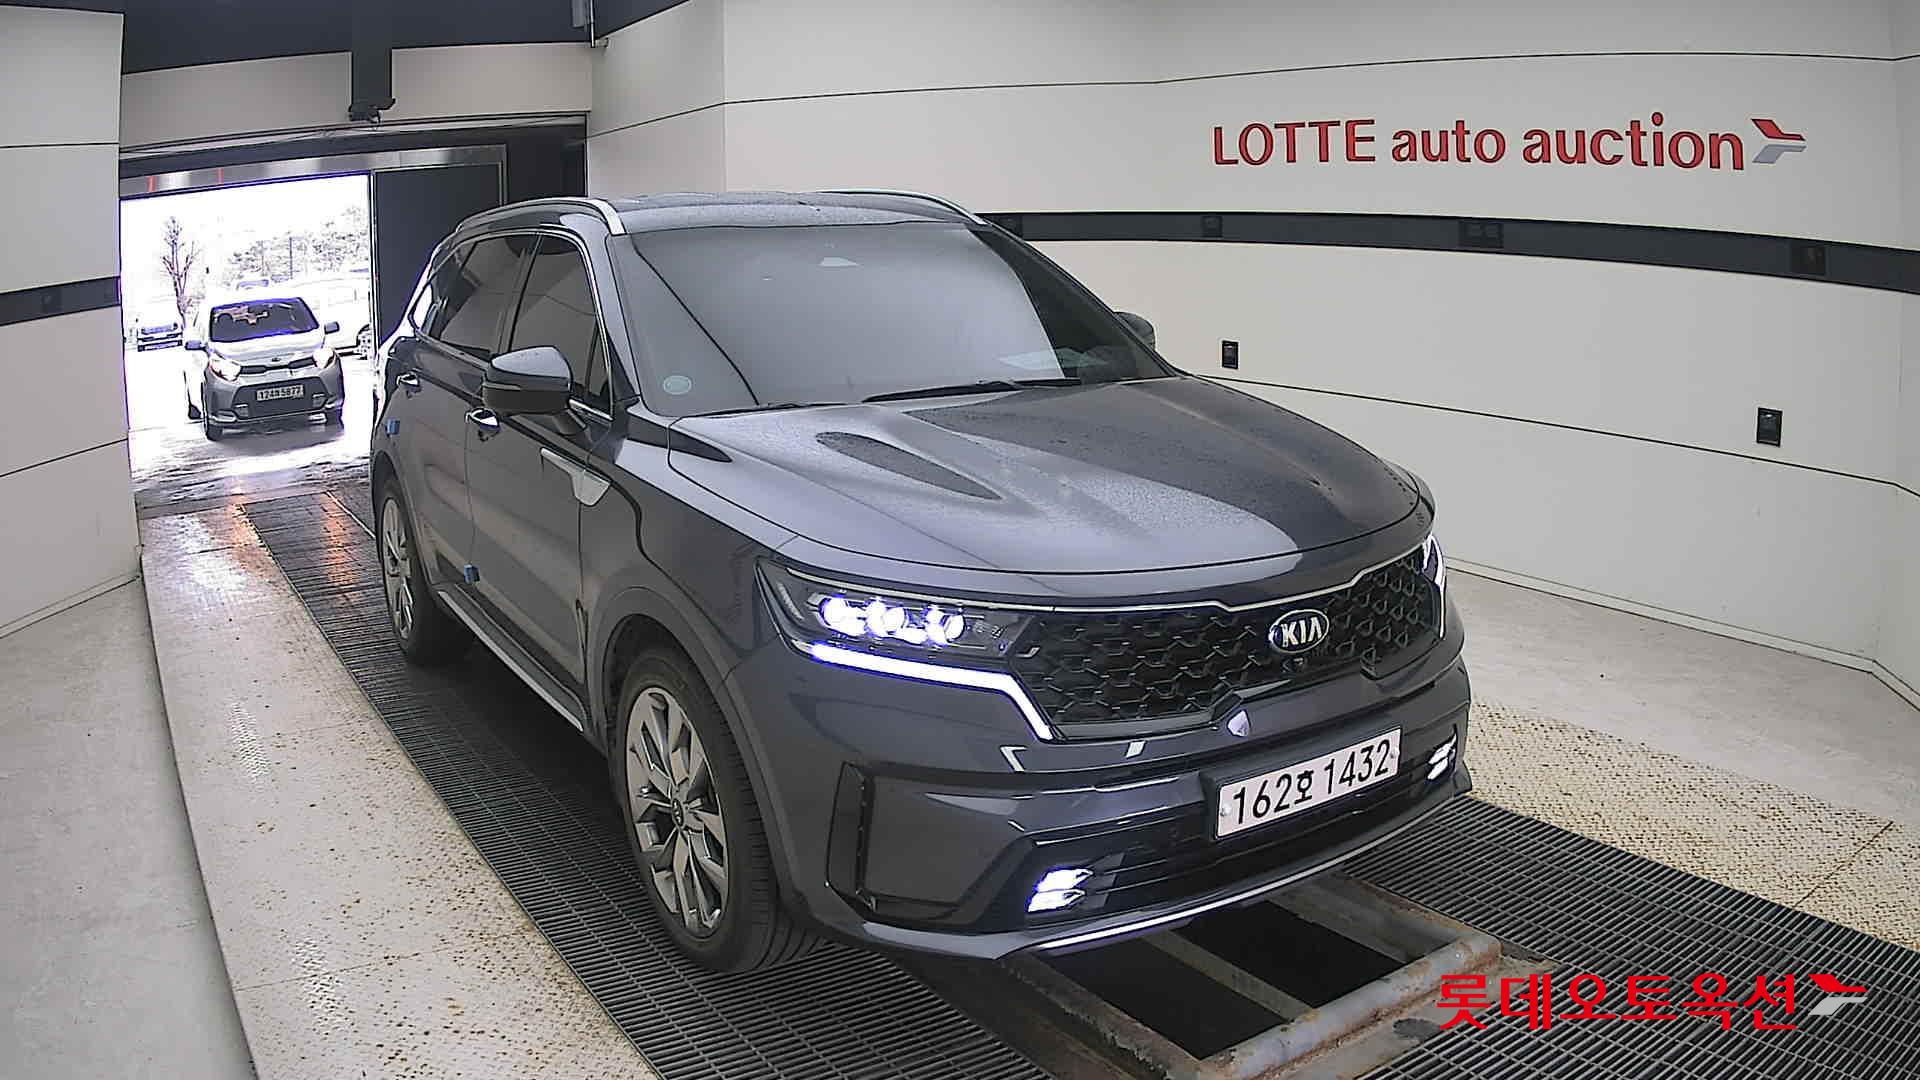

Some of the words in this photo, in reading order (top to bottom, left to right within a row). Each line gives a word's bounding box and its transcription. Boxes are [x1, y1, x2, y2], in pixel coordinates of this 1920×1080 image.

[1213, 119, 1376, 166] LOTTE
[1391, 119, 1507, 164] auto
[1522, 111, 1745, 171] auction
[1280, 616, 1323, 648] KIA
[1233, 769, 1314, 825] 162호
[1323, 739, 1391, 795] 1432
